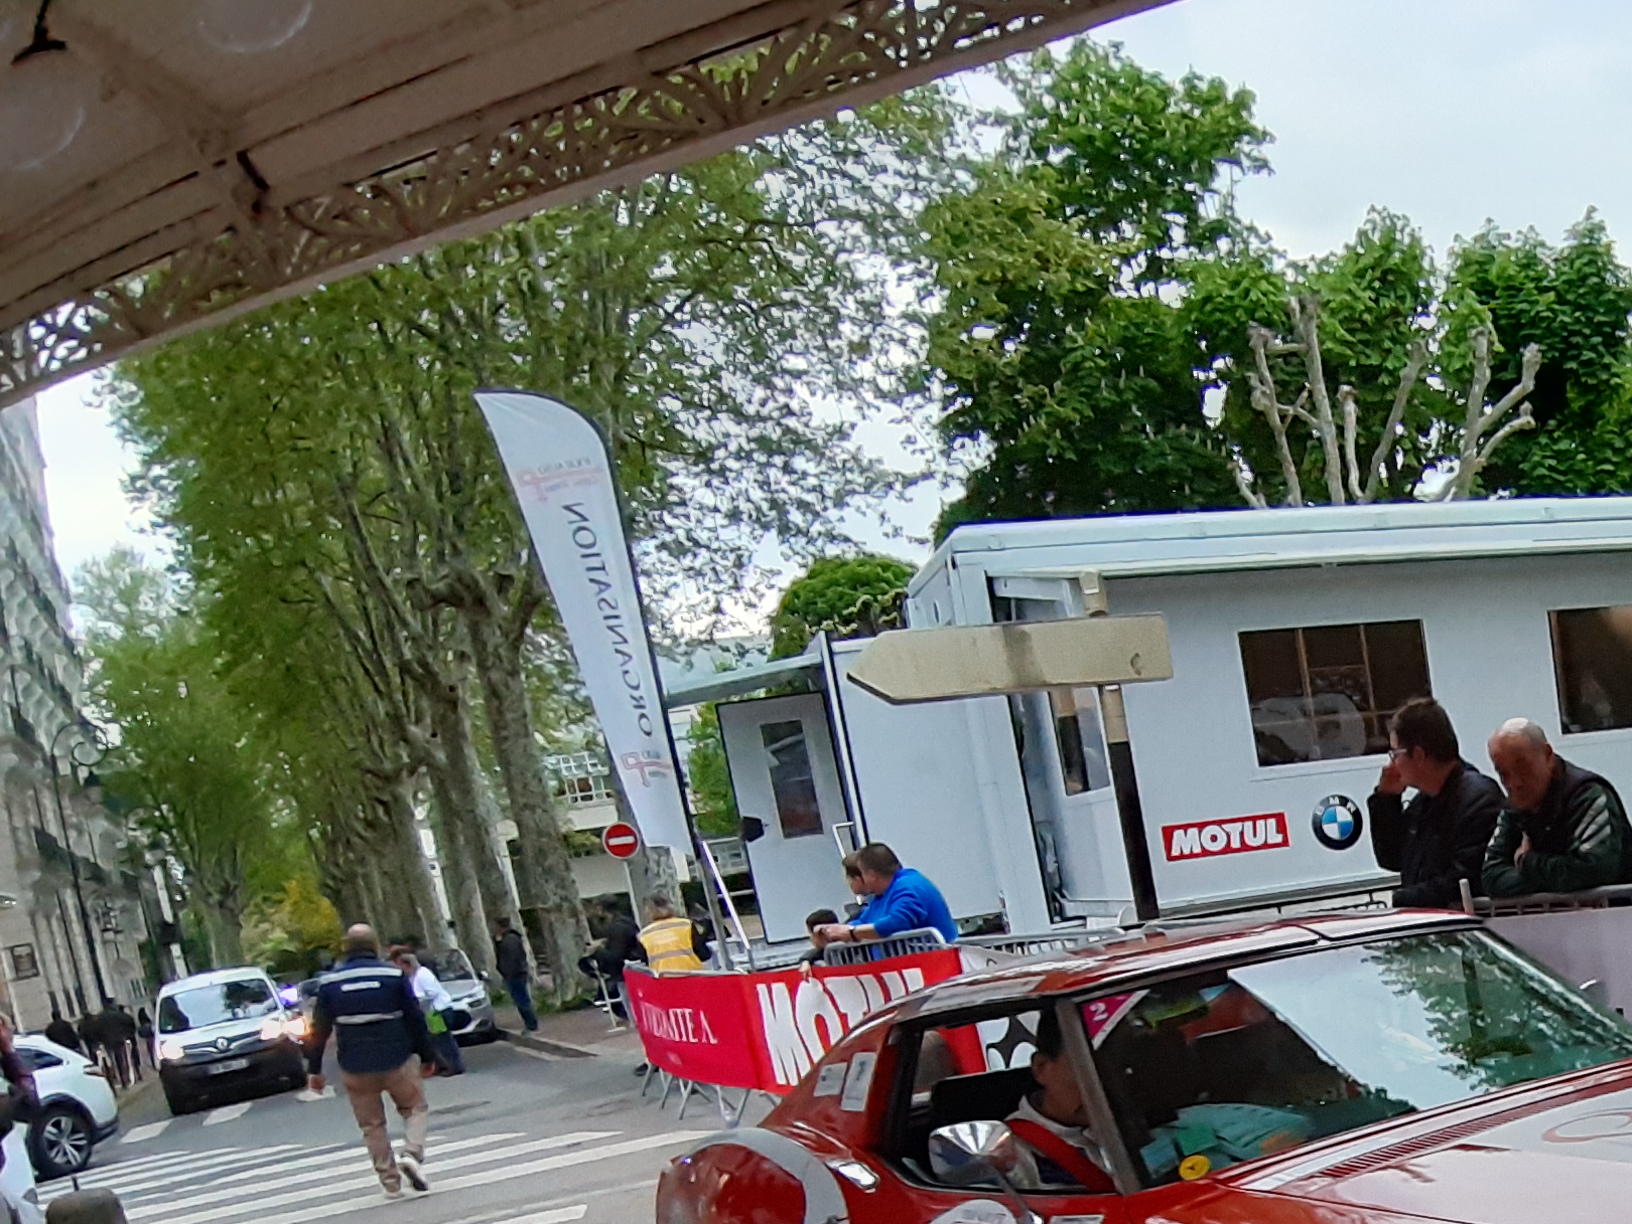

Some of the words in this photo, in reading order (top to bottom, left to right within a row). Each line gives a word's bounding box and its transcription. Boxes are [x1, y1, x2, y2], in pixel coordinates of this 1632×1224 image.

[1171, 817, 1284, 857] MOTUL
[756, 967, 925, 1086] MOT
[1088, 1002, 1109, 1021] 2
